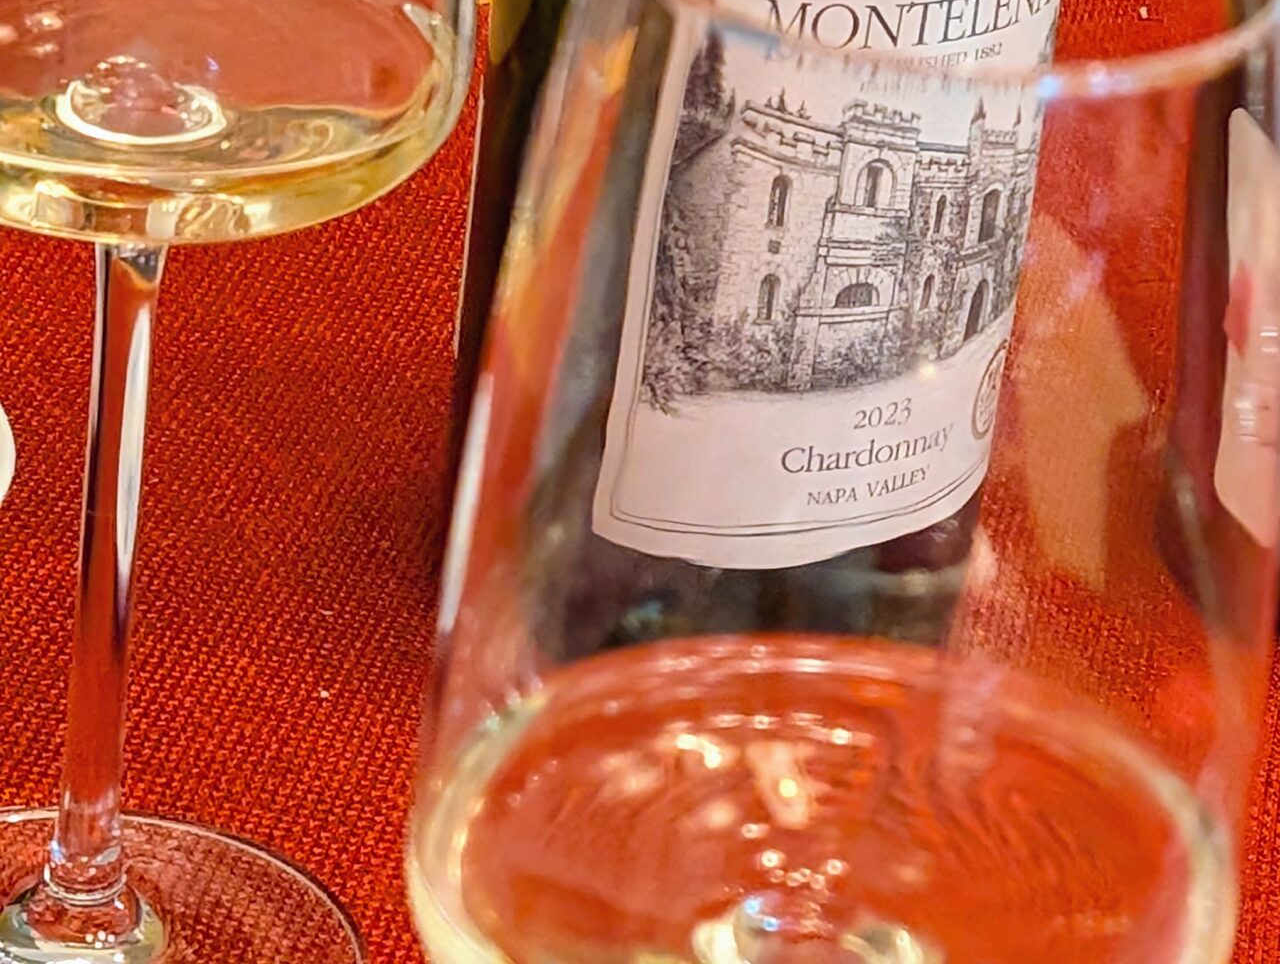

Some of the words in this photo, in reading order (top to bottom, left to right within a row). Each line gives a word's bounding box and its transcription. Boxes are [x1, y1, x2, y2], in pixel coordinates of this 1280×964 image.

[853, 397, 913, 430] 2023
[781, 423, 954, 474] Chardonnay
[806, 487, 859, 506] NAPA
[866, 464, 931, 499] VALLEY
